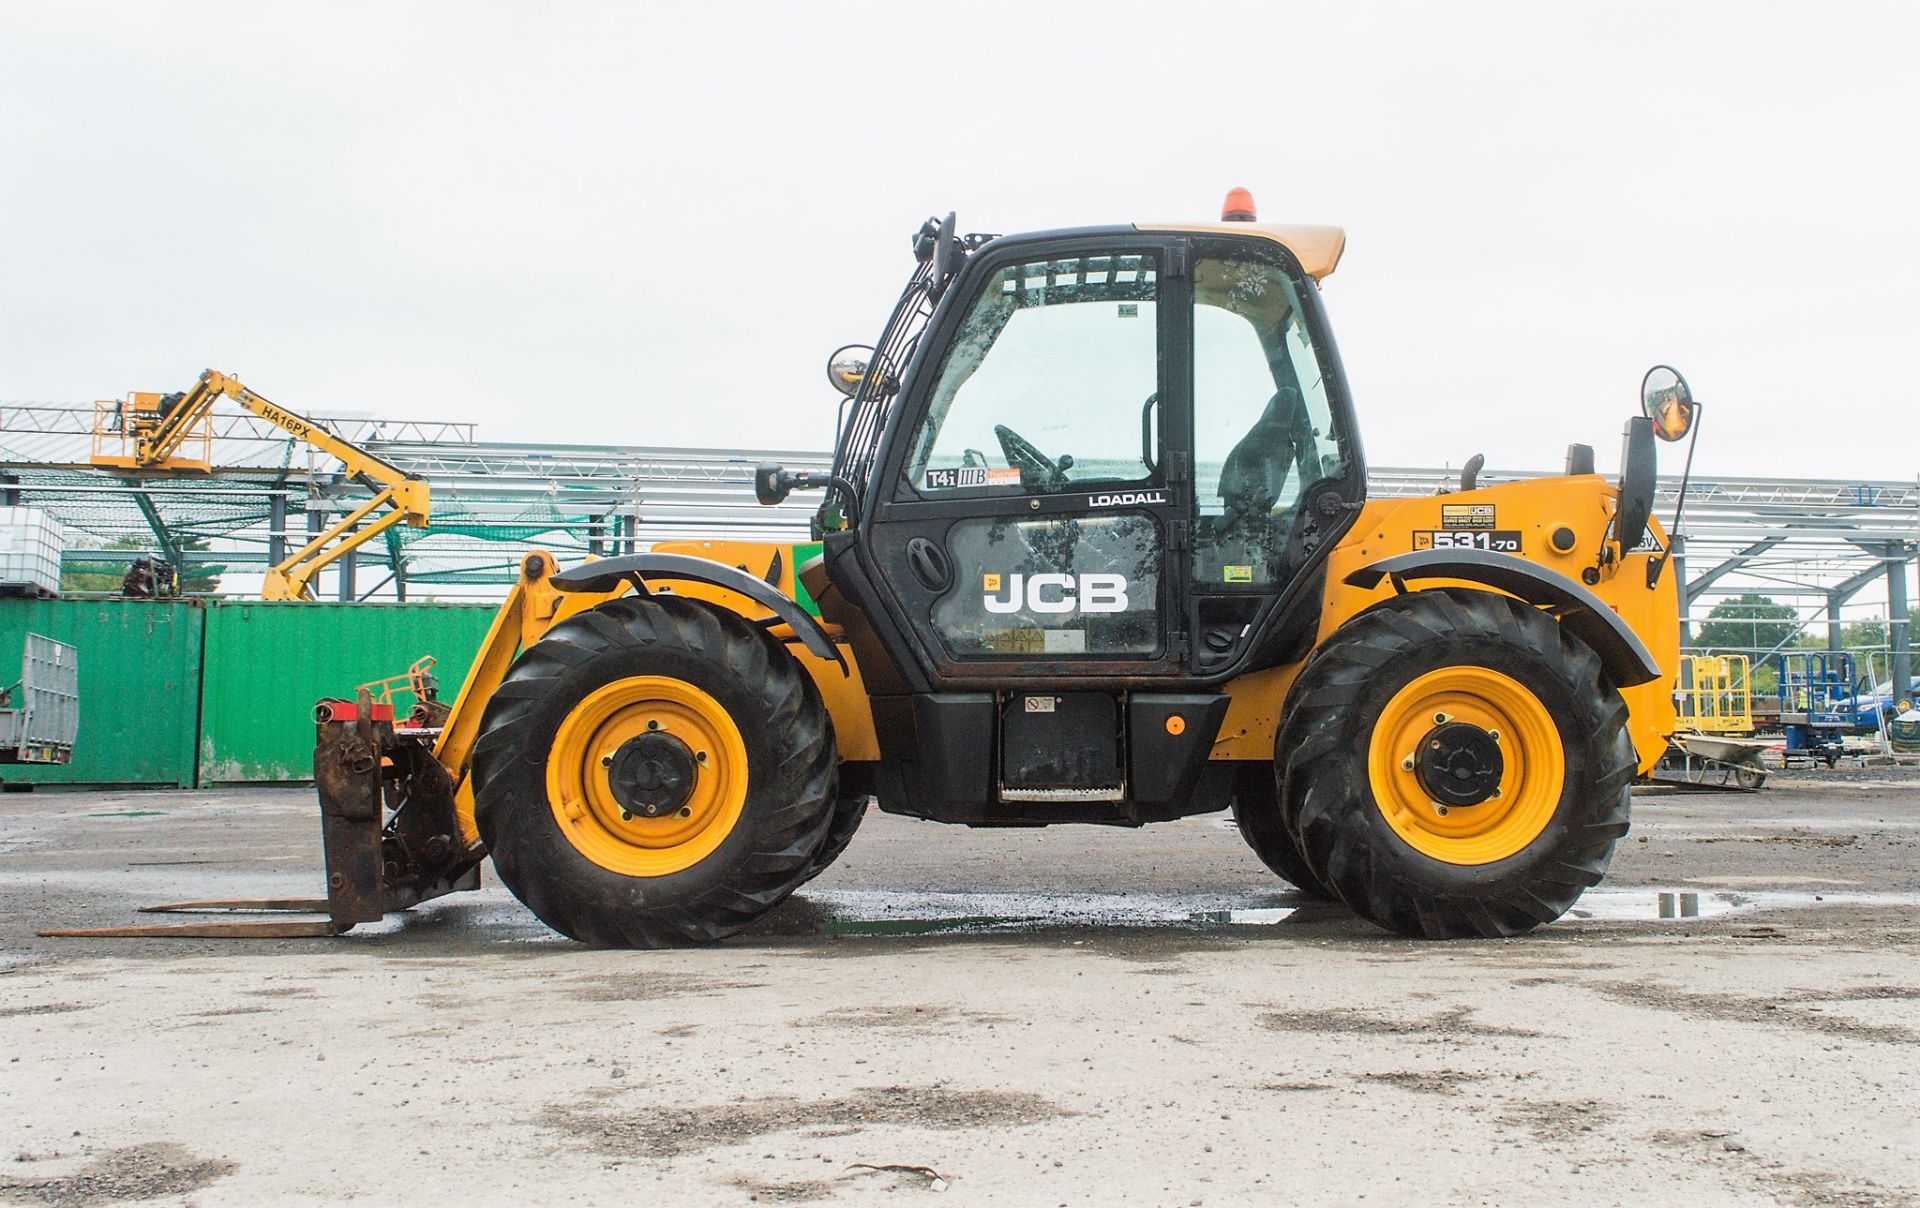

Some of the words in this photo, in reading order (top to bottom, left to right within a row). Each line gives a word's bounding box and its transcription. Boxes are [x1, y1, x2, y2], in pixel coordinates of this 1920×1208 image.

[262, 406, 311, 438] HA16PX
[928, 471, 956, 487] T4i
[1089, 492, 1166, 507] LOADALL
[983, 573, 1129, 614] JCB
